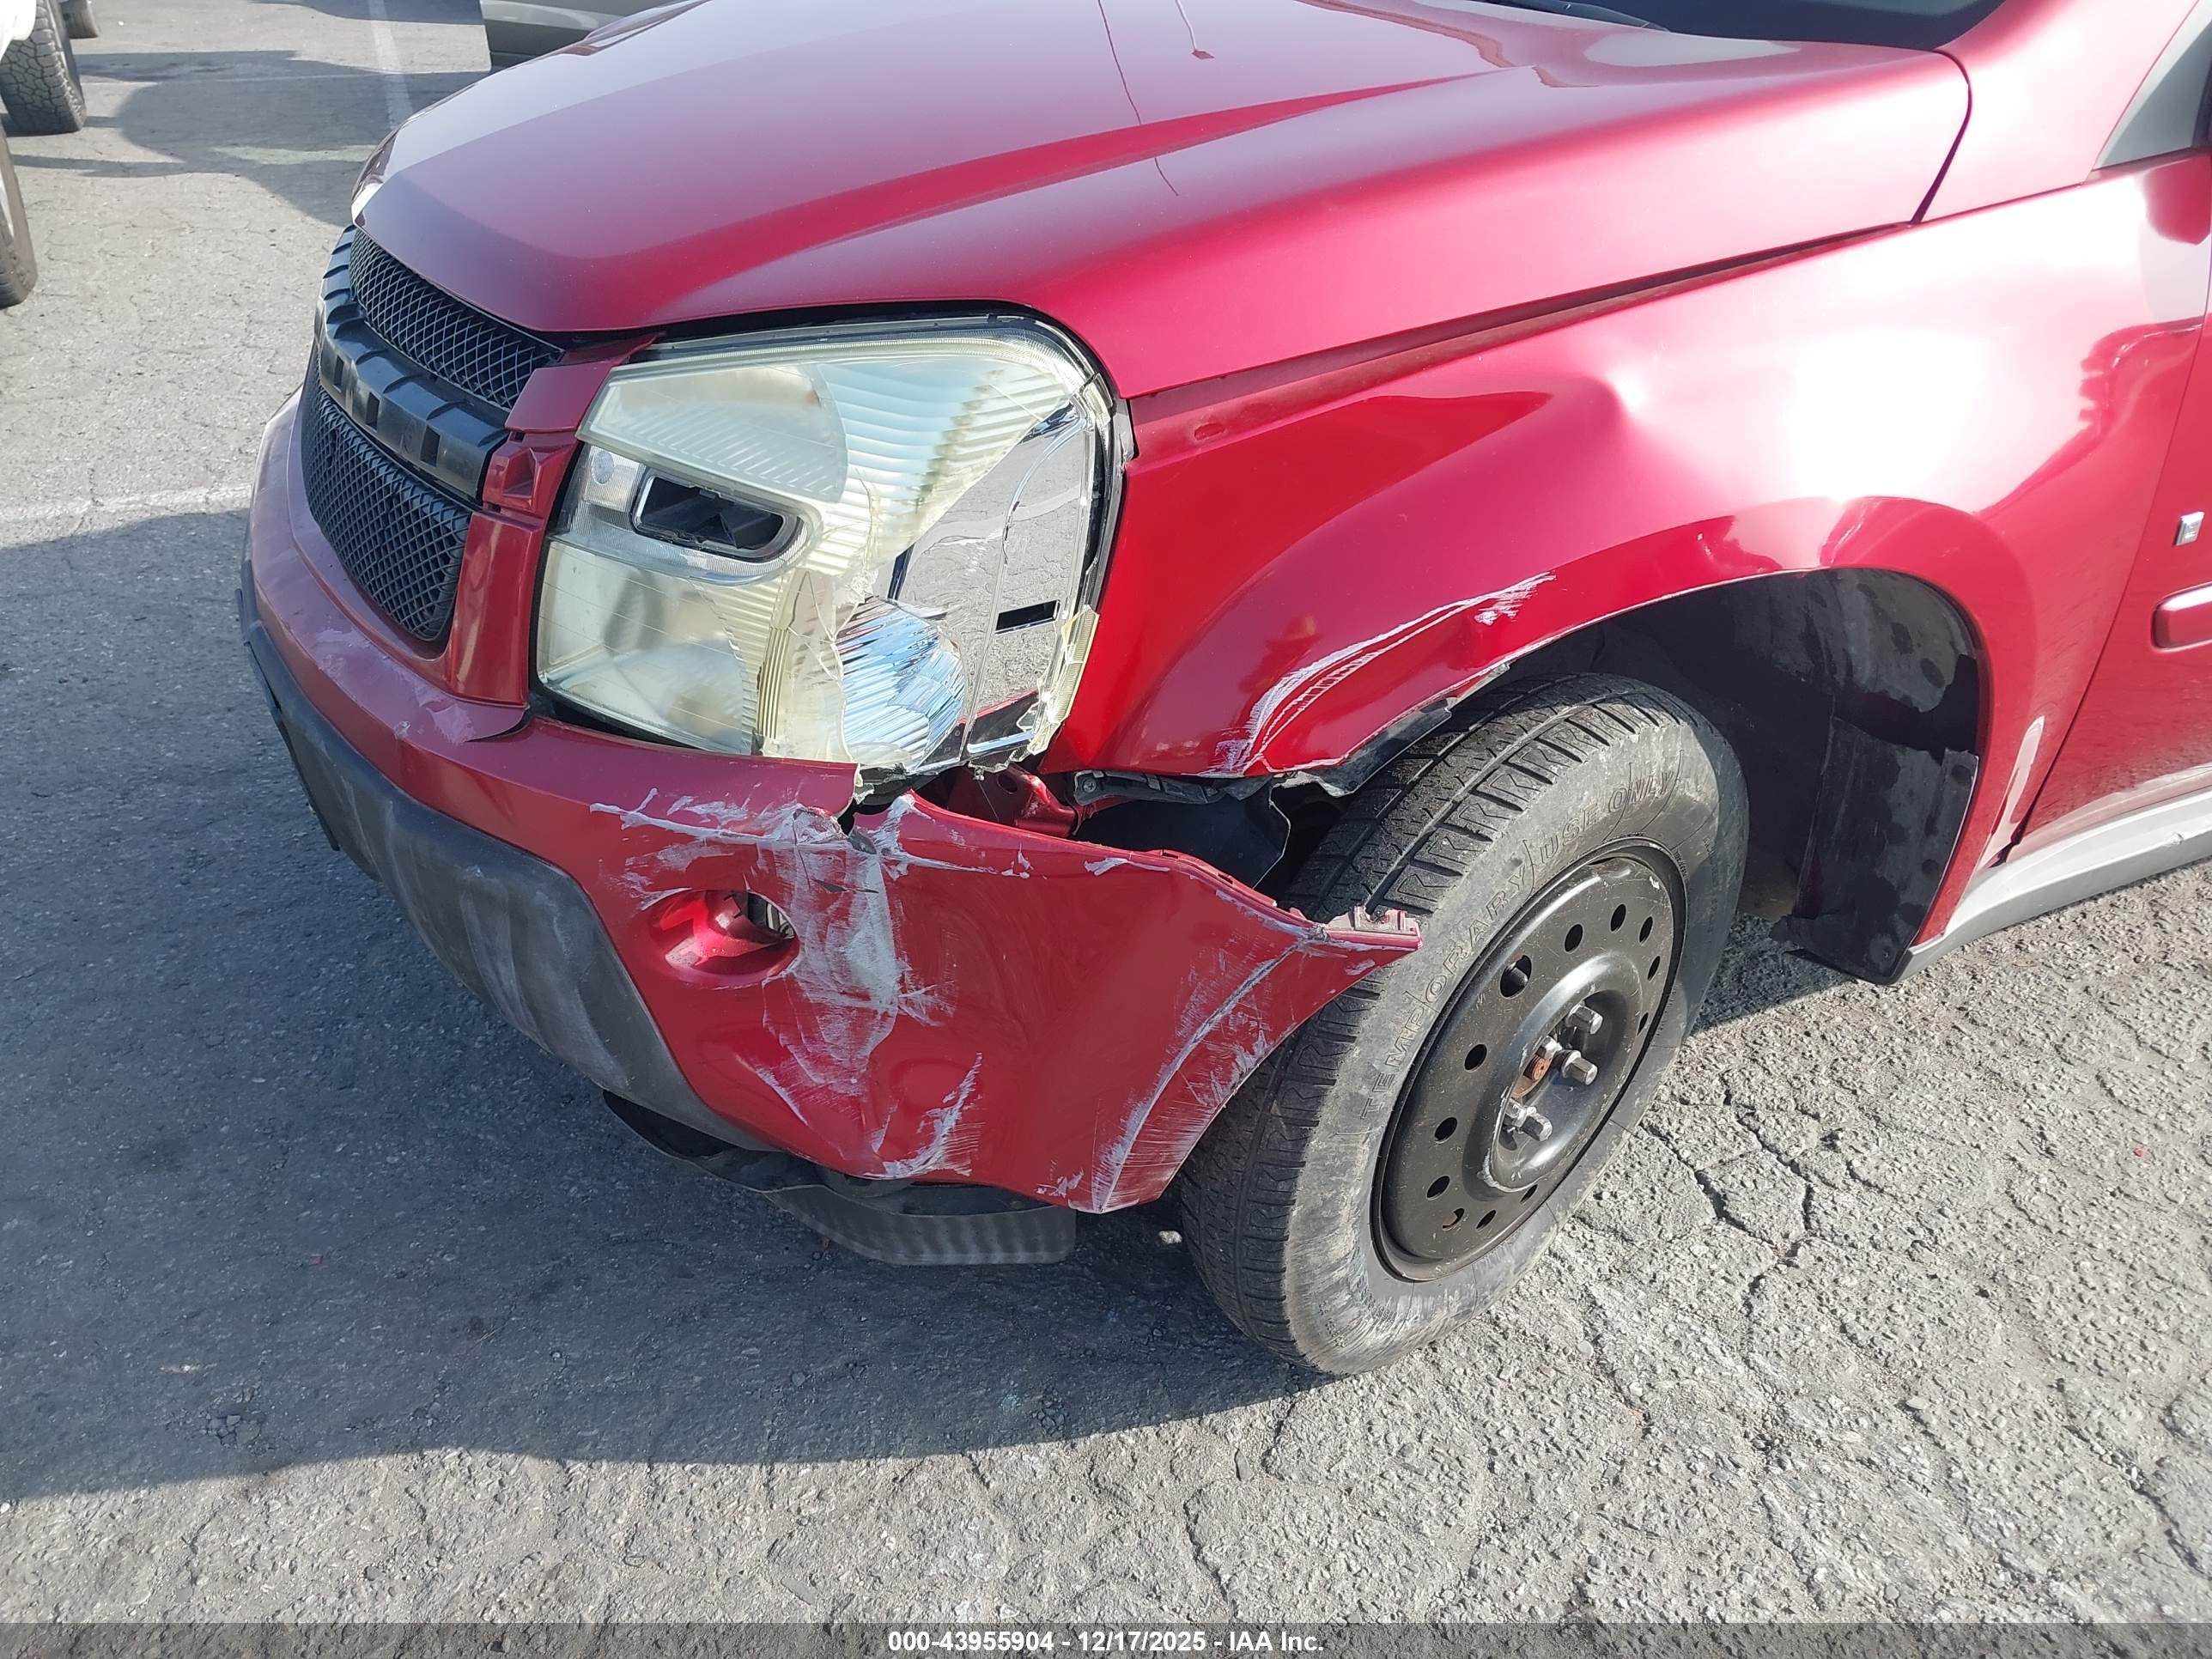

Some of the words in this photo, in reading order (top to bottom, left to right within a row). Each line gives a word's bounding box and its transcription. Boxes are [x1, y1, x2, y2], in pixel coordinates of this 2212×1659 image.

[1360, 864, 1527, 1120] TEMPORARY
[1540, 803, 1601, 864] USE
[1608, 770, 1674, 812] ONLY
